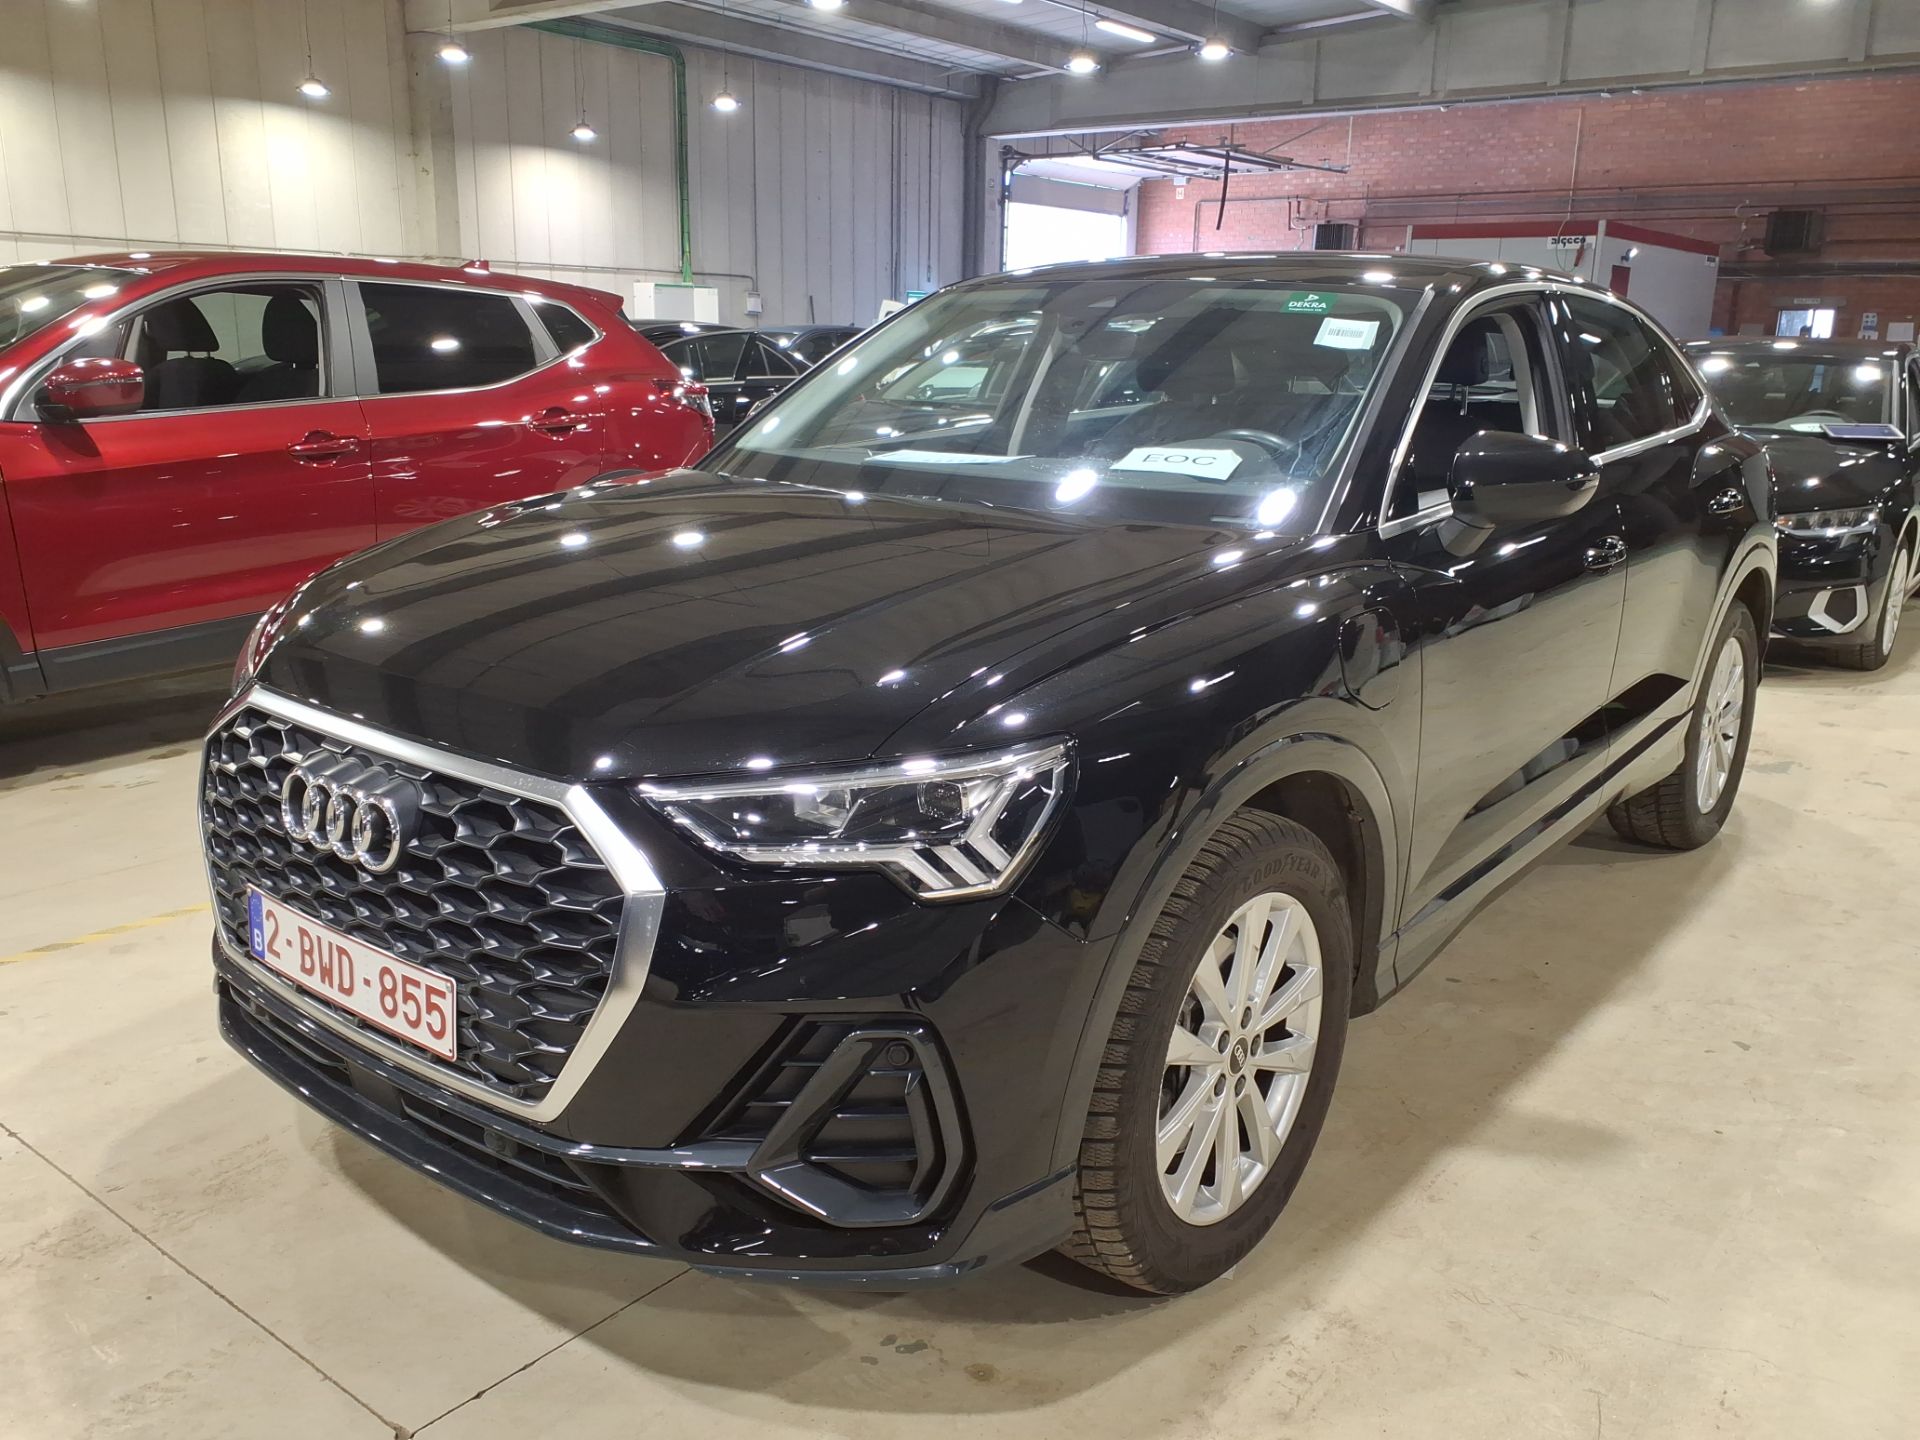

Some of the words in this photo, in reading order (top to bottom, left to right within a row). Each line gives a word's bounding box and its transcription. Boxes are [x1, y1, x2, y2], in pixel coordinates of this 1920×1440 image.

[1288, 301, 1327, 309] DEKRA
[1142, 453, 1217, 466] EOC
[254, 928, 264, 951] B
[265, 908, 447, 1041] 2-BWD-855
